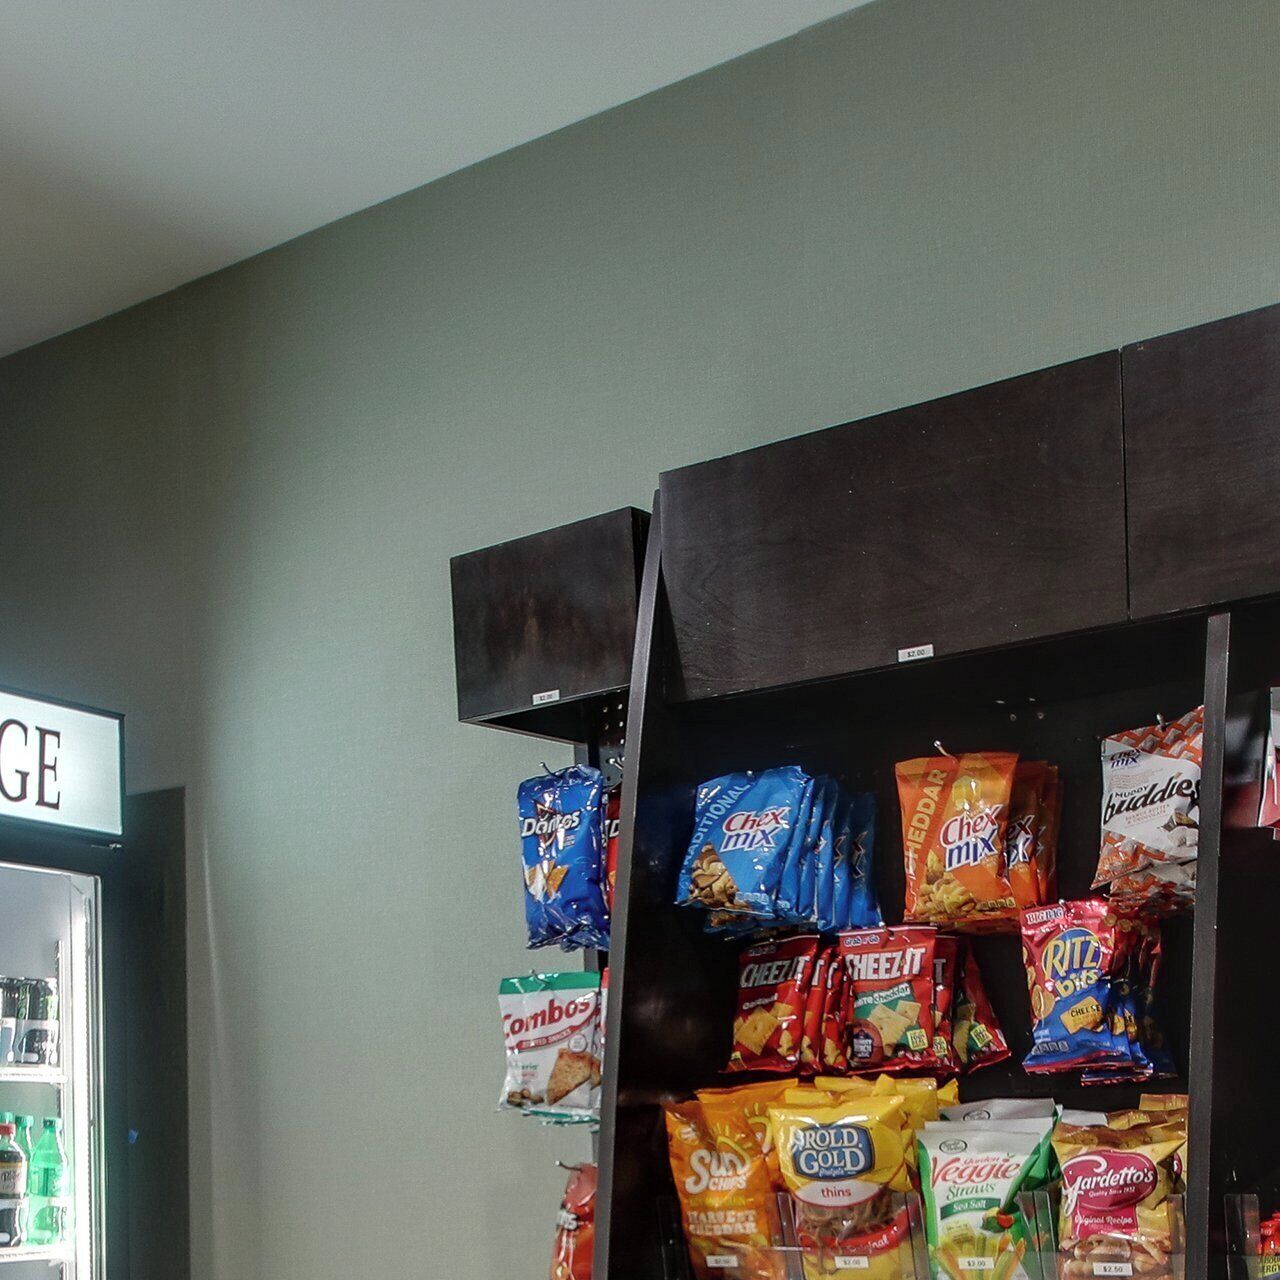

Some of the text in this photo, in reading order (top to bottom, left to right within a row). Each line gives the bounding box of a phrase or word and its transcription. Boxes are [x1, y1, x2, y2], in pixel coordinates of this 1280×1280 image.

[1115, 785, 1149, 798] MUDDY
[522, 809, 582, 838] Doritos
[723, 806, 791, 833] Chex
[941, 804, 1003, 847] Chex
[720, 828, 780, 852] mix
[946, 828, 998, 872] mix
[1026, 908, 1064, 924] BIG BAG
[1045, 935, 1100, 981] RITZ
[1055, 969, 1100, 998] bits
[799, 1149, 866, 1174] GOLD
[931, 1155, 1020, 1189] Veggie
[708, 1175, 747, 1191] CHIPS
[821, 1186, 852, 1198] thins
[946, 1182, 996, 1201] Straws
[1062, 1154, 1154, 1216] Gardetto's
[952, 1199, 987, 1211] Sea Salt
[687, 1209, 757, 1224] HARVEST
[1105, 1216, 1133, 1226] Recipe
[689, 1222, 757, 1235] CHEDDAR
[1103, 1265, 1123, 1273] $2.50
